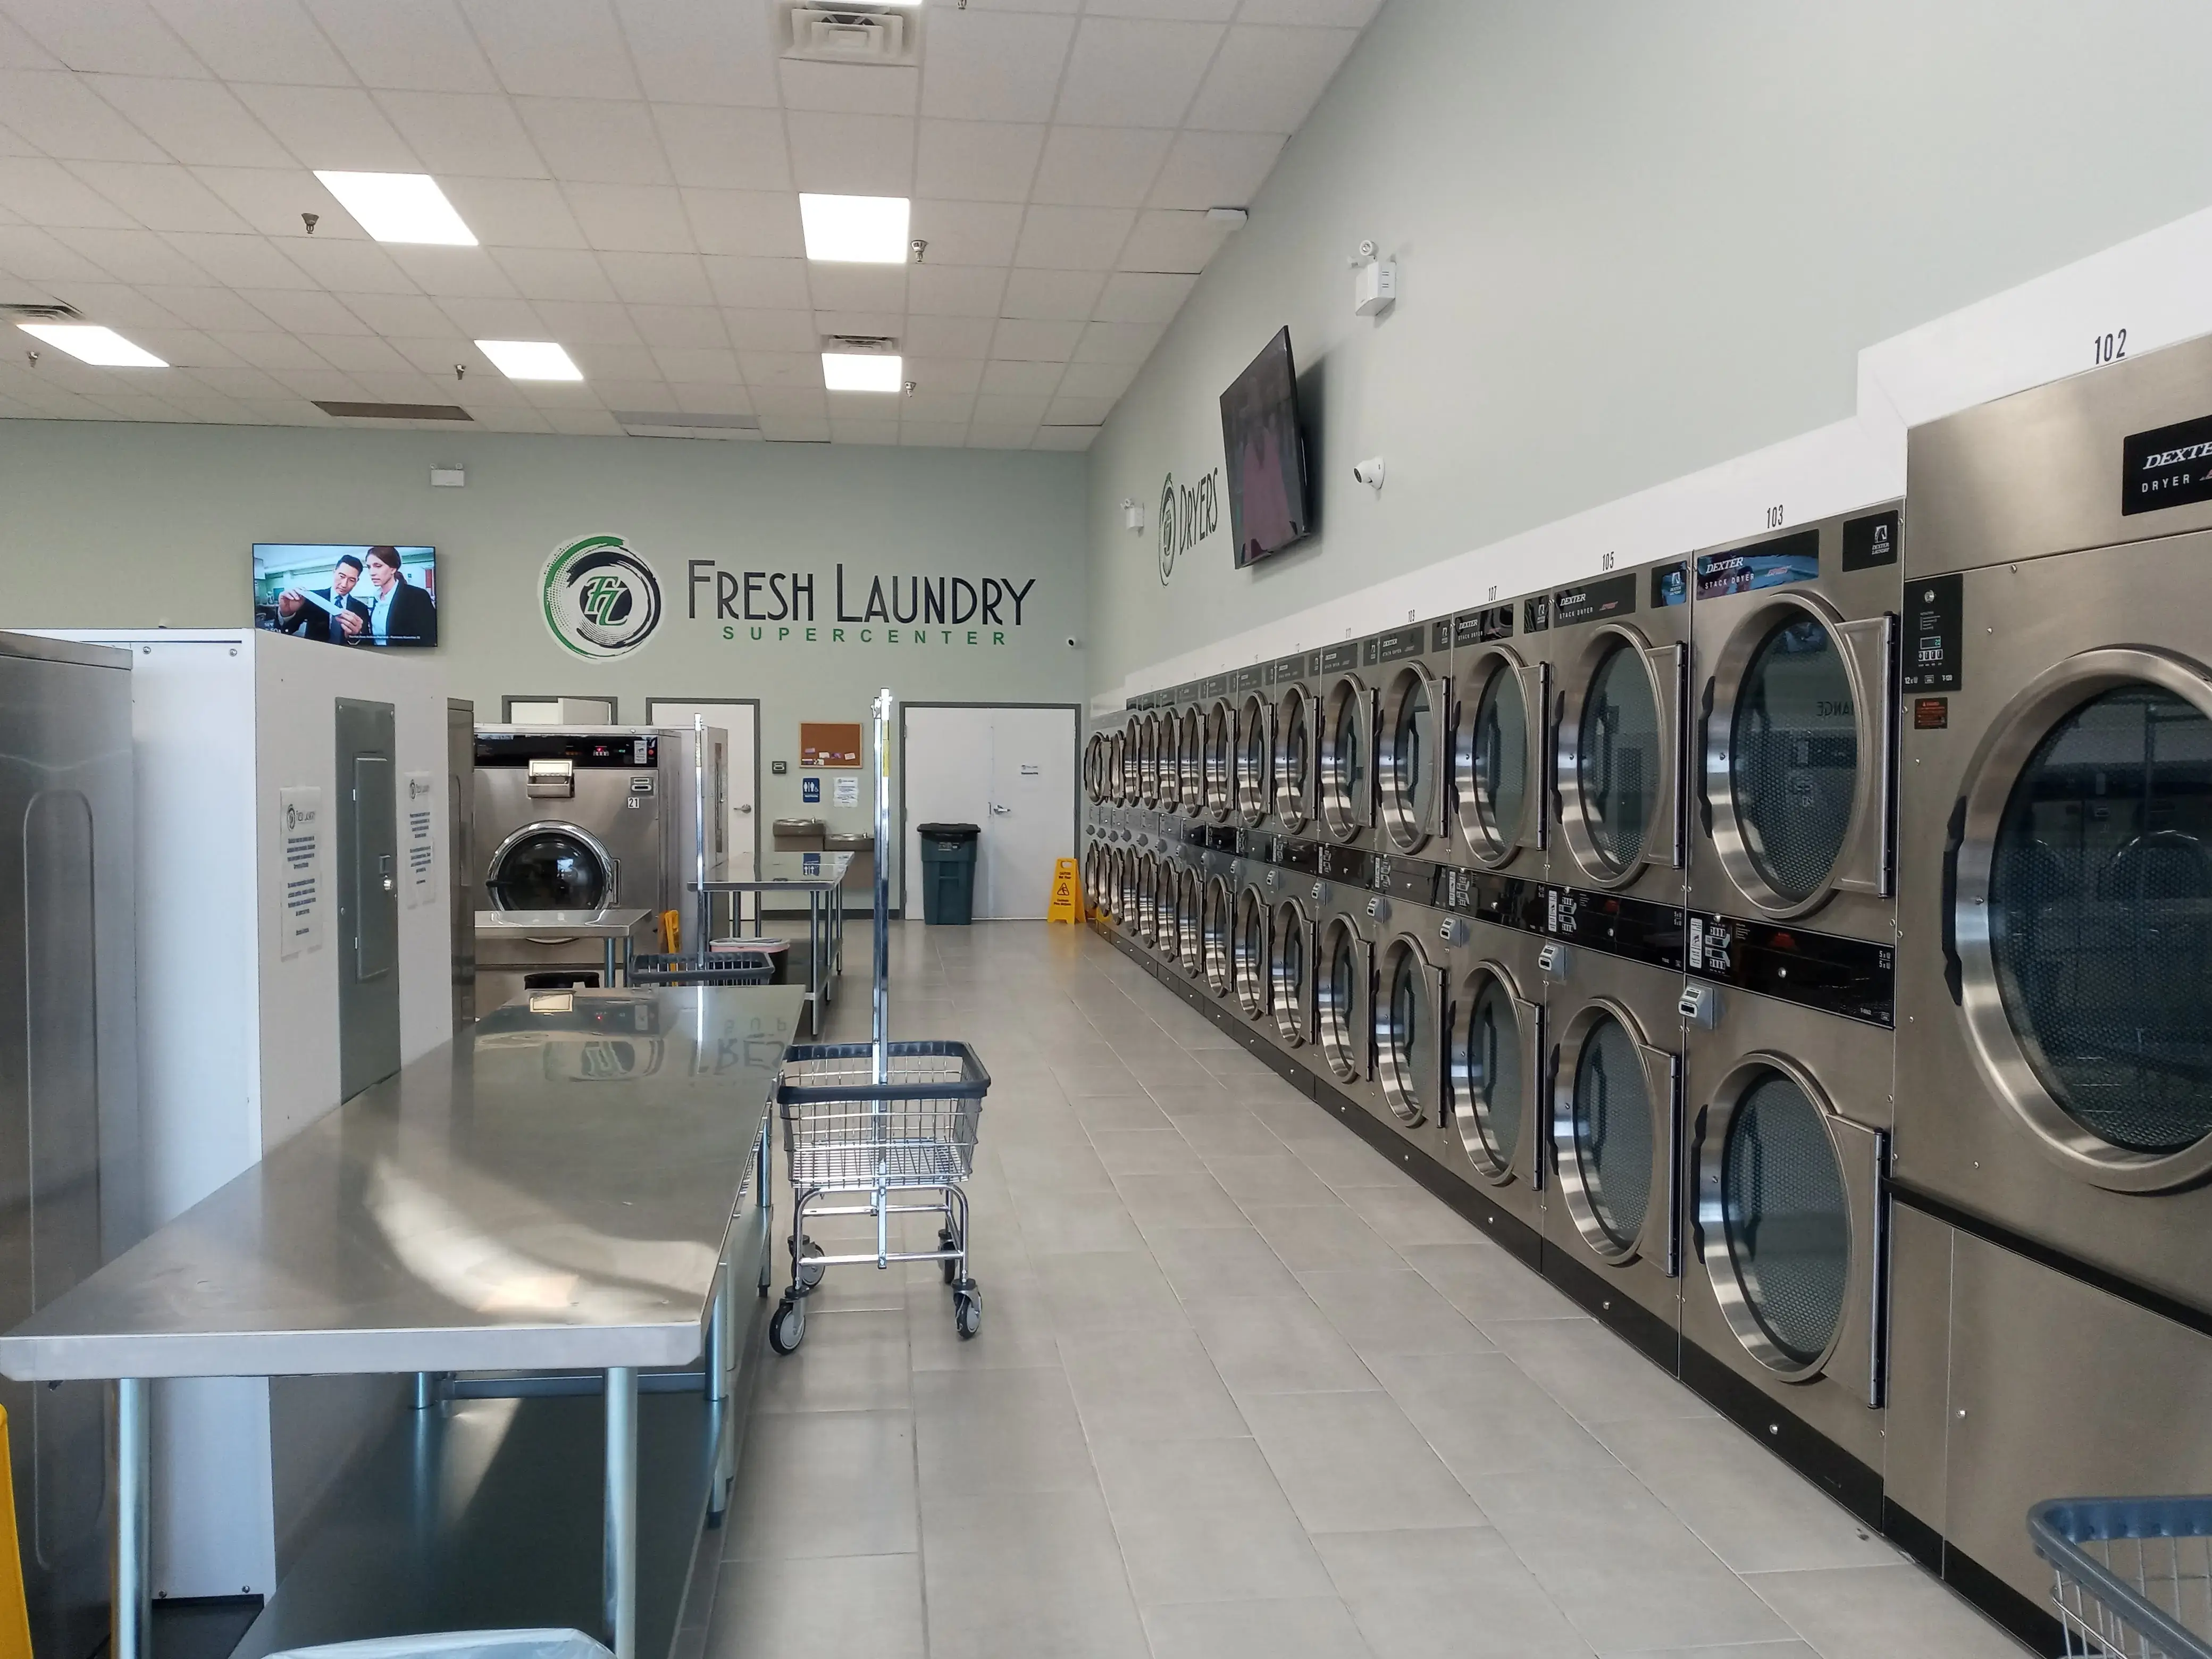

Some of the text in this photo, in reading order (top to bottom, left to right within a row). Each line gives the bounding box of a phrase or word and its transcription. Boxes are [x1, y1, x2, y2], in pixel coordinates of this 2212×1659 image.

[2094, 328, 2127, 365] 102
[2142, 441, 2212, 470] DEXTE
[2142, 474, 2190, 492] DRYER
[1179, 467, 1218, 556] DRYERS
[1767, 505, 1783, 529] 103
[1602, 551, 1614, 571] 105
[1706, 557, 1744, 574] DEXTER
[1705, 573, 1754, 590] STACK DRYER
[1560, 593, 1586, 606] DEXTER
[1459, 619, 1478, 630] DEXTER
[723, 625, 1006, 645] SUPERCENTER
[629, 799, 638, 807] 21
